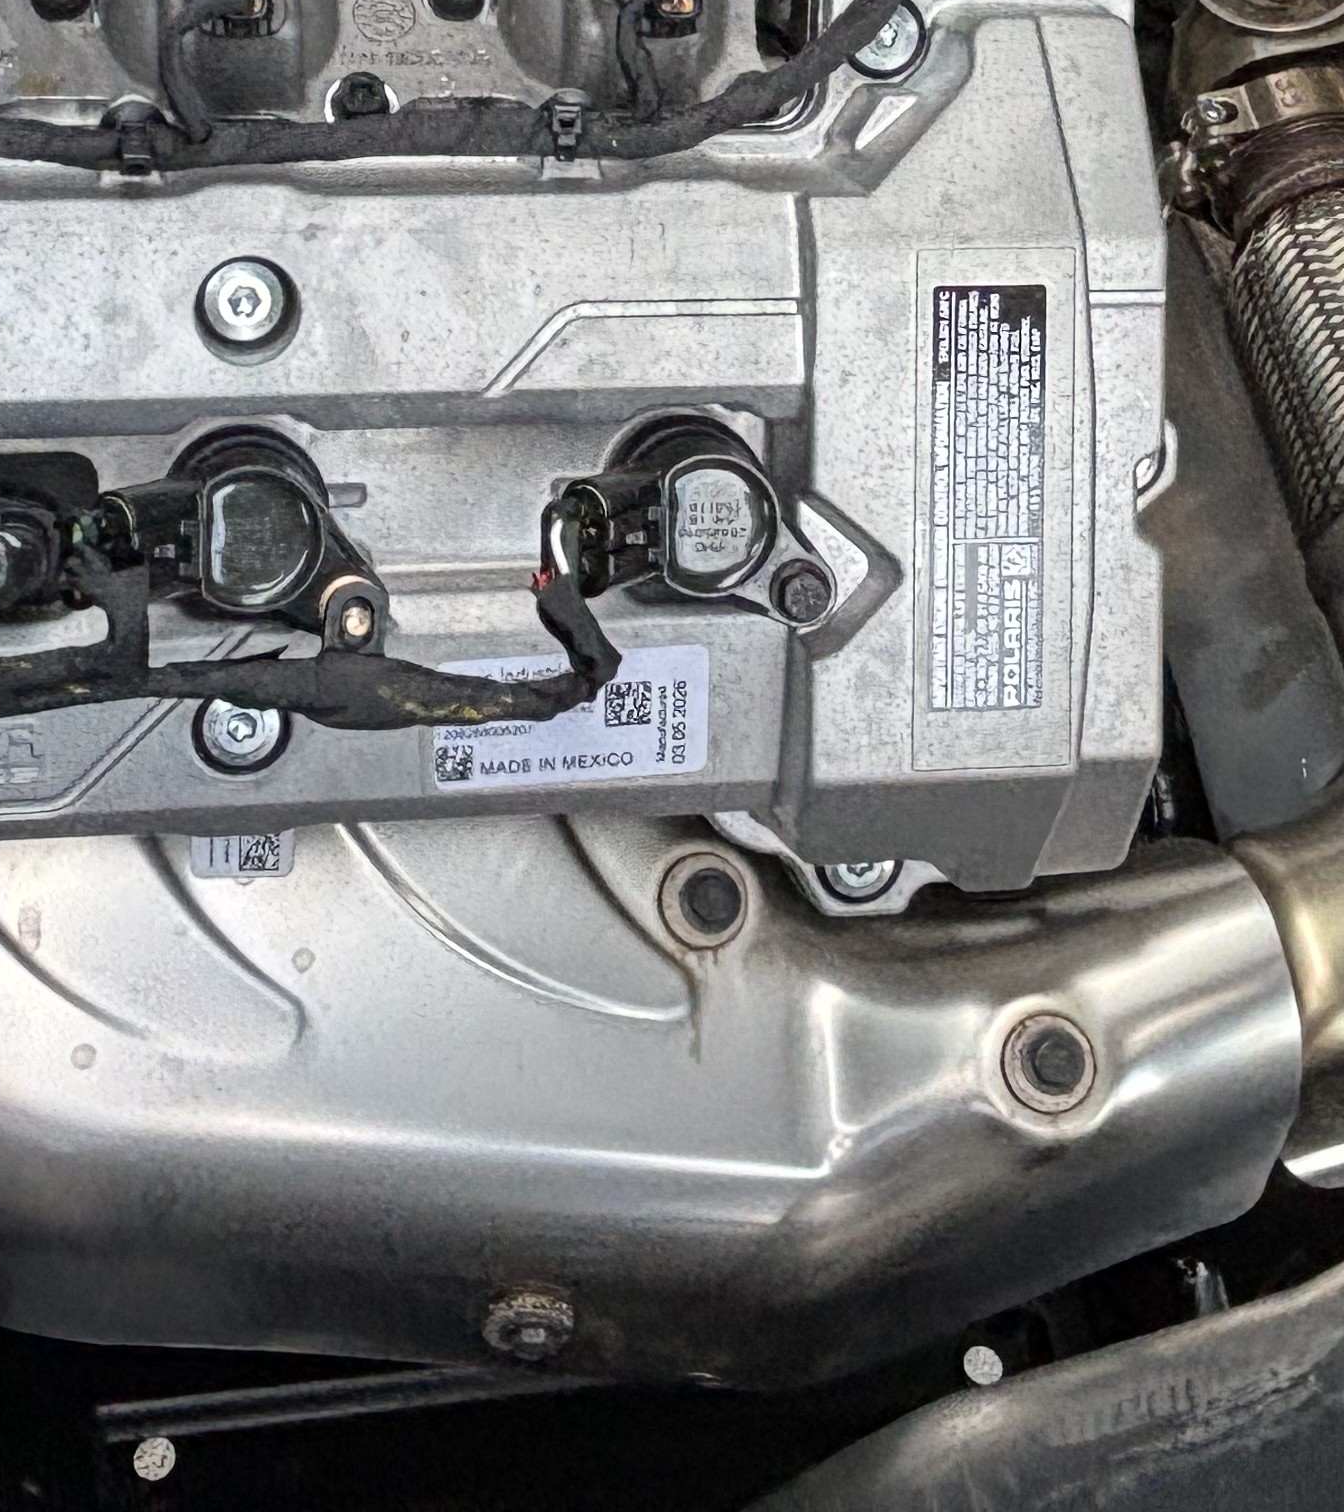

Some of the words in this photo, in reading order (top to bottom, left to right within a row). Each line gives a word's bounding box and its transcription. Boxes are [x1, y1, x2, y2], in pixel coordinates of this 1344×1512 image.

[1003, 579, 1021, 707] POLARIS
[672, 679, 687, 718] 2026
[480, 758, 531, 775] MADE
[539, 756, 556, 771] IN
[563, 751, 634, 770] MEXICO
